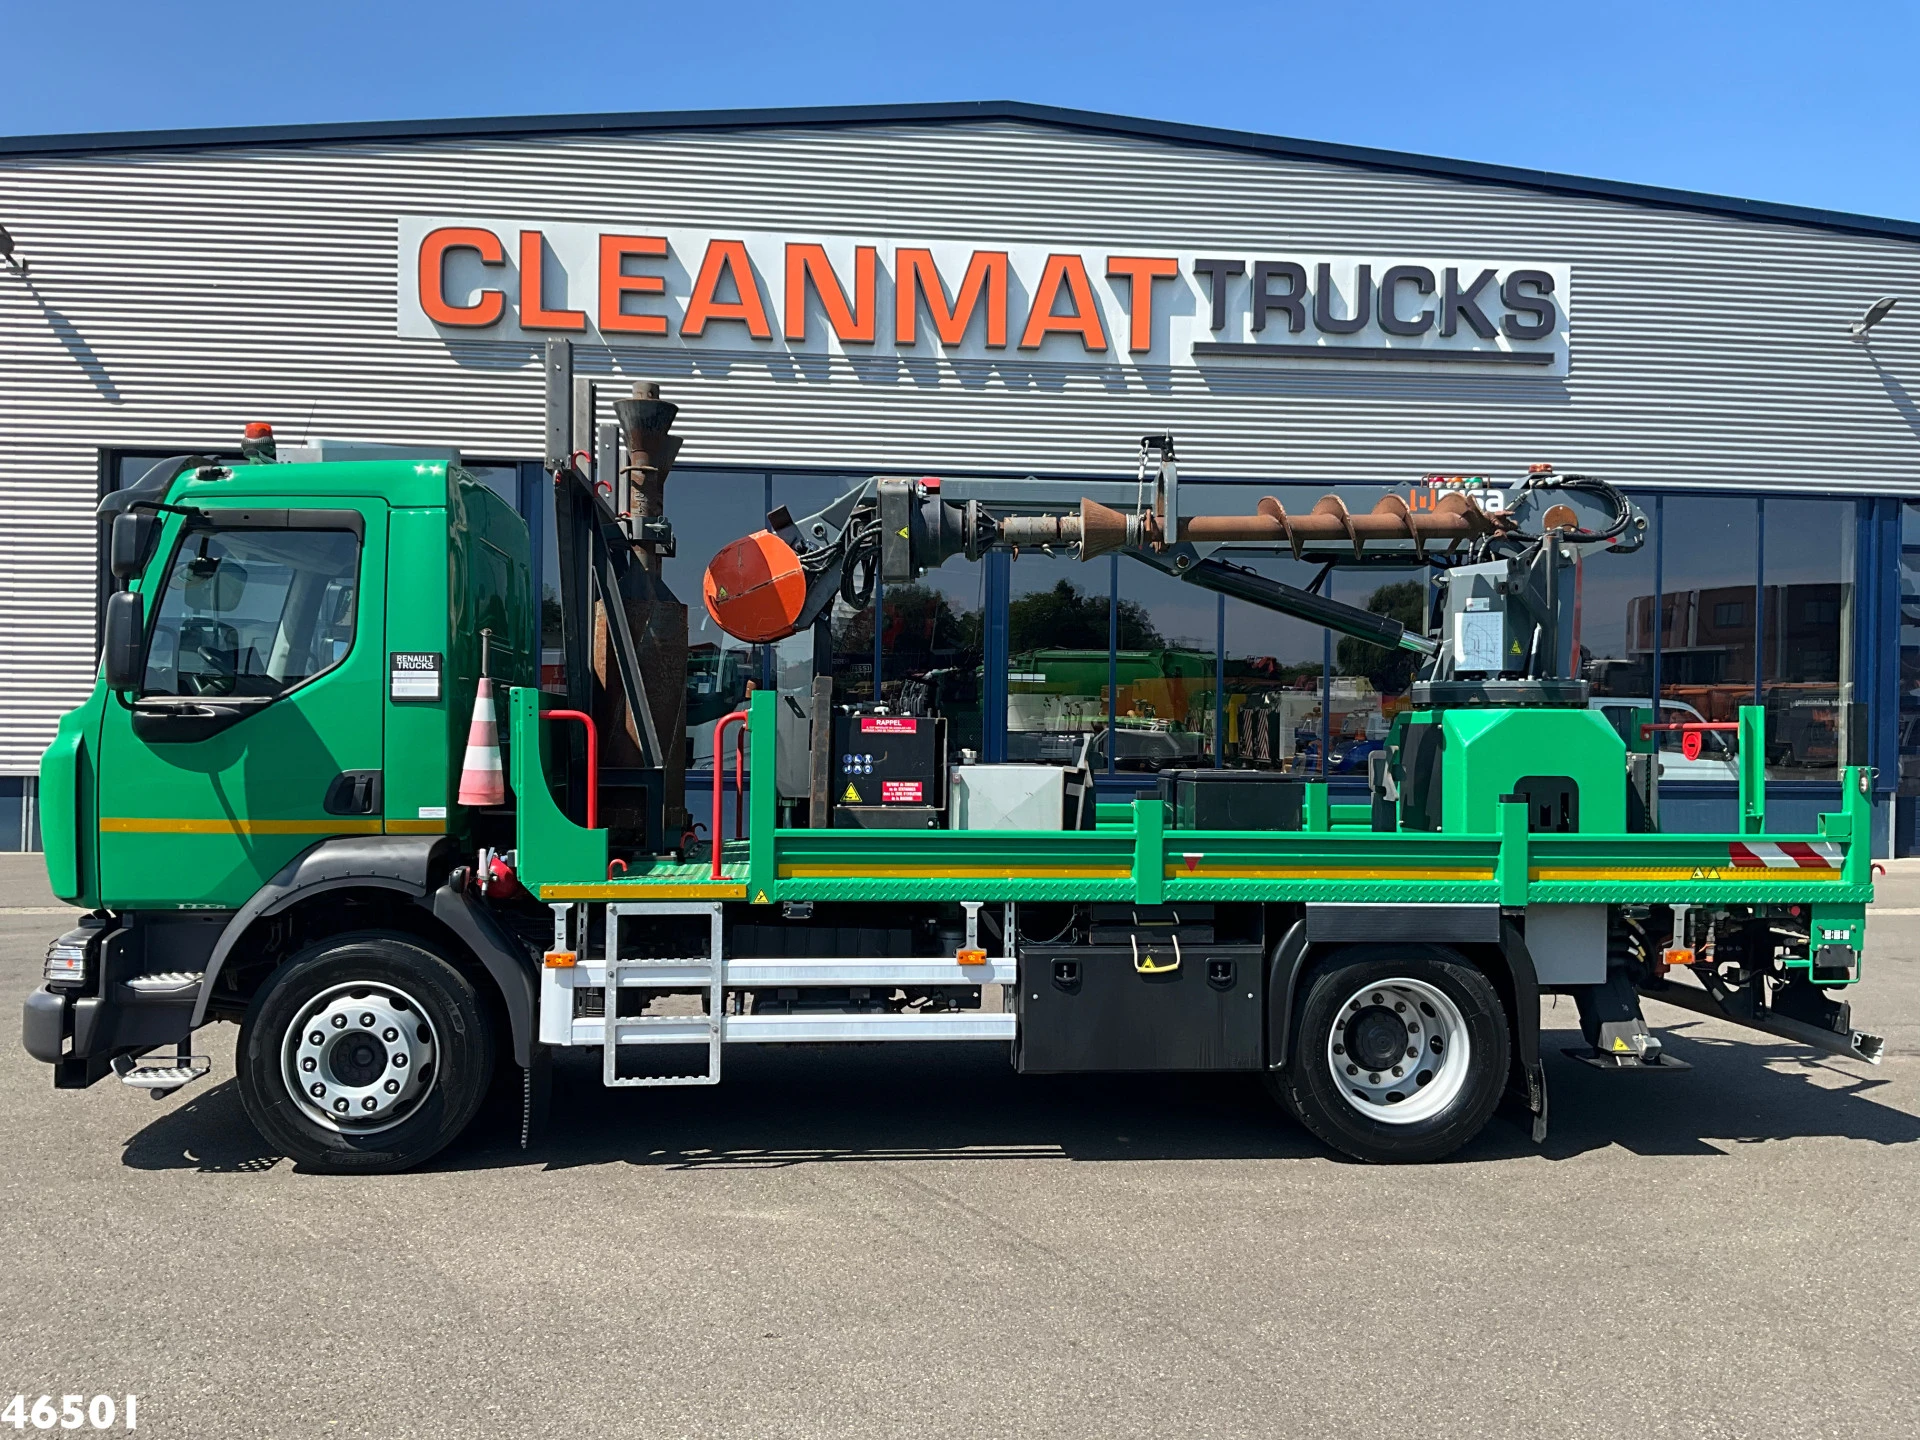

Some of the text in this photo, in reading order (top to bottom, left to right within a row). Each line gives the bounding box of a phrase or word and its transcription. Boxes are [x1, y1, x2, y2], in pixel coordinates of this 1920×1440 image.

[417, 226, 1556, 354] CLEANMAT TRUCKS
[396, 654, 434, 663] RENAULT
[397, 662, 434, 670] TRUCKS
